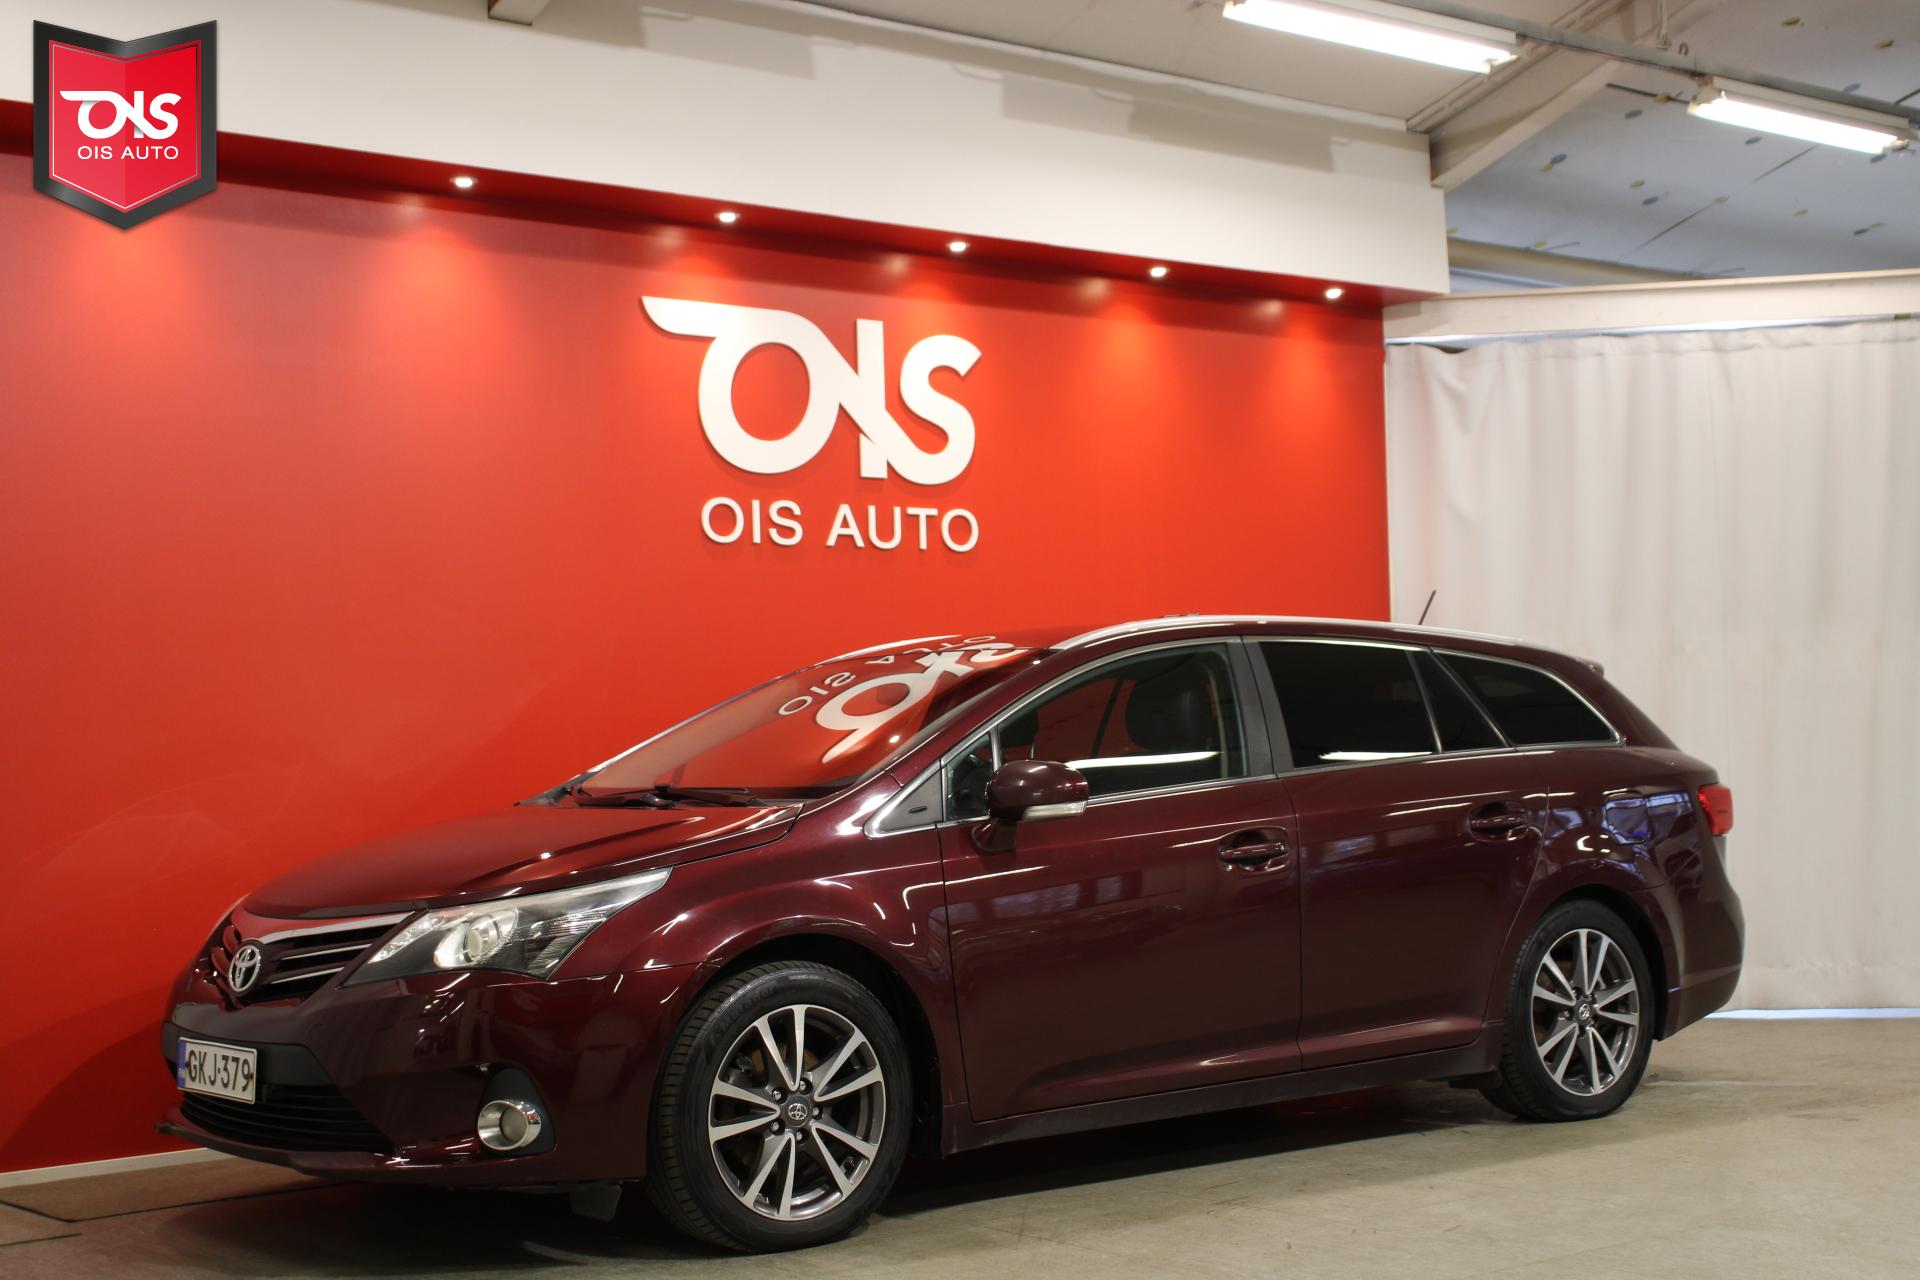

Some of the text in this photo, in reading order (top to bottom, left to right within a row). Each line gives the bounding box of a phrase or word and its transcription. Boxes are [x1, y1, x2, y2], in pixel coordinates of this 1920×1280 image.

[641, 296, 982, 485] OIS
[701, 497, 979, 552] OIS AUTO
[188, 1049, 252, 1092] GKJ-379
